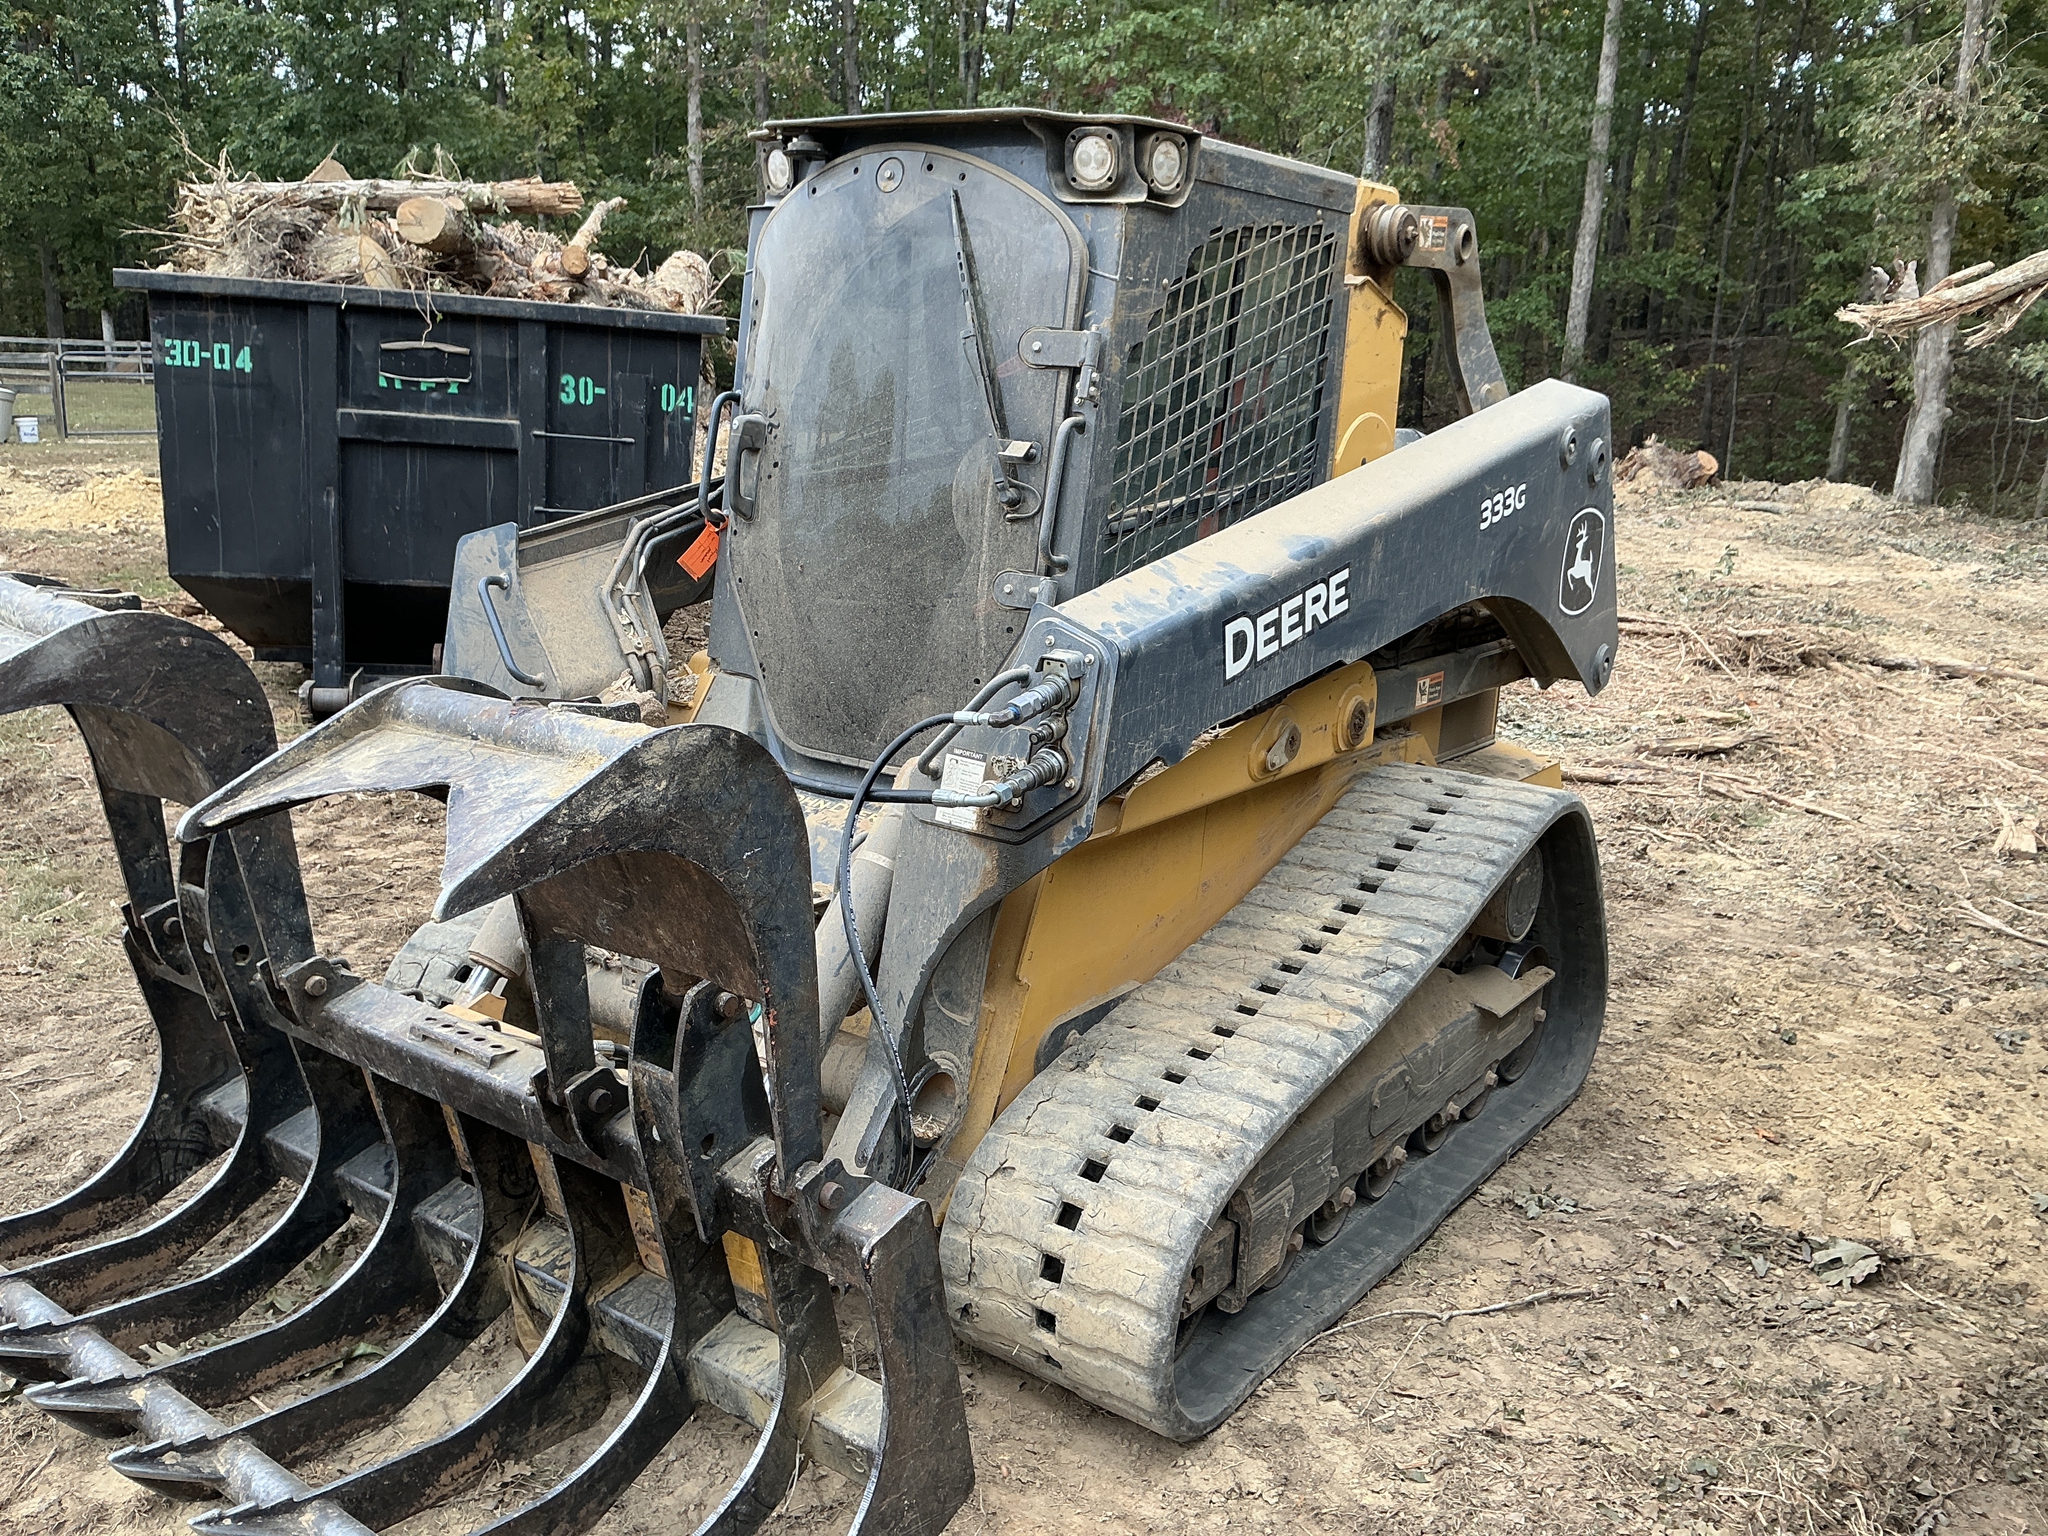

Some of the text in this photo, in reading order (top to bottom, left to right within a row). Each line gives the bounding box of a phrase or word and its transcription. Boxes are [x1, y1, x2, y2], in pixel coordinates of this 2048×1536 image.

[164, 338, 253, 373] 30-04
[1479, 482, 1527, 531] 333G
[1224, 567, 1350, 681] DEERE
[953, 747, 984, 761] IMPORTANT
